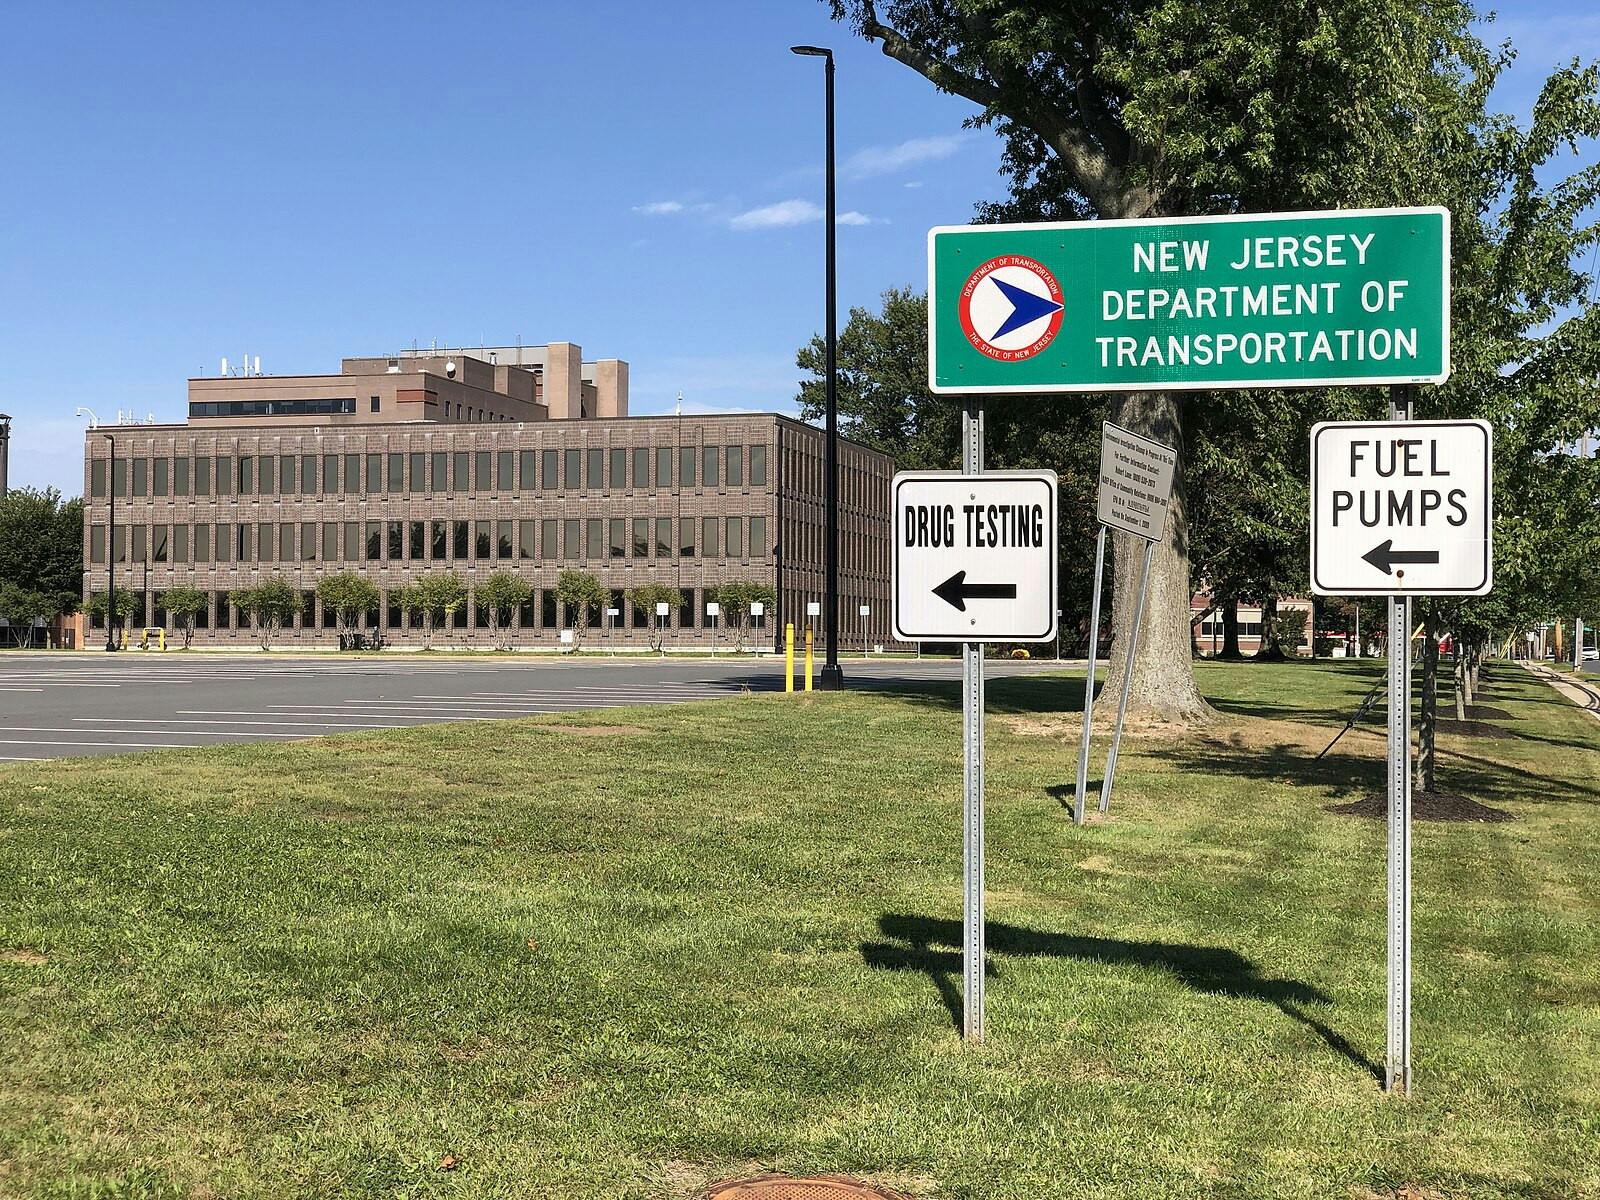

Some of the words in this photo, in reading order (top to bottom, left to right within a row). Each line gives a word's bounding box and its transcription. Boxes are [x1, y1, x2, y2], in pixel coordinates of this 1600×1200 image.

[1133, 240, 1210, 273] NEW
[1230, 233, 1376, 270] JERSEY
[964, 262, 997, 298] DEPARTMENT
[998, 258, 1009, 266] OF
[1012, 258, 1059, 295] TRANSPORTATION
[1102, 282, 1341, 321] DEPARTMENT
[1360, 280, 1408, 313] OF
[969, 332, 979, 345] THE
[980, 344, 1000, 358] STATE
[1003, 350, 1012, 359] OF
[1015, 350, 1030, 359] NEW
[1033, 330, 1054, 353] JERSEY
[1096, 328, 1418, 368] TRANSPORTATION
[1350, 440, 1450, 477] FUEL
[906, 504, 954, 548] DRUG
[963, 504, 1043, 548] TESTING
[1332, 489, 1468, 527] PUMPS
